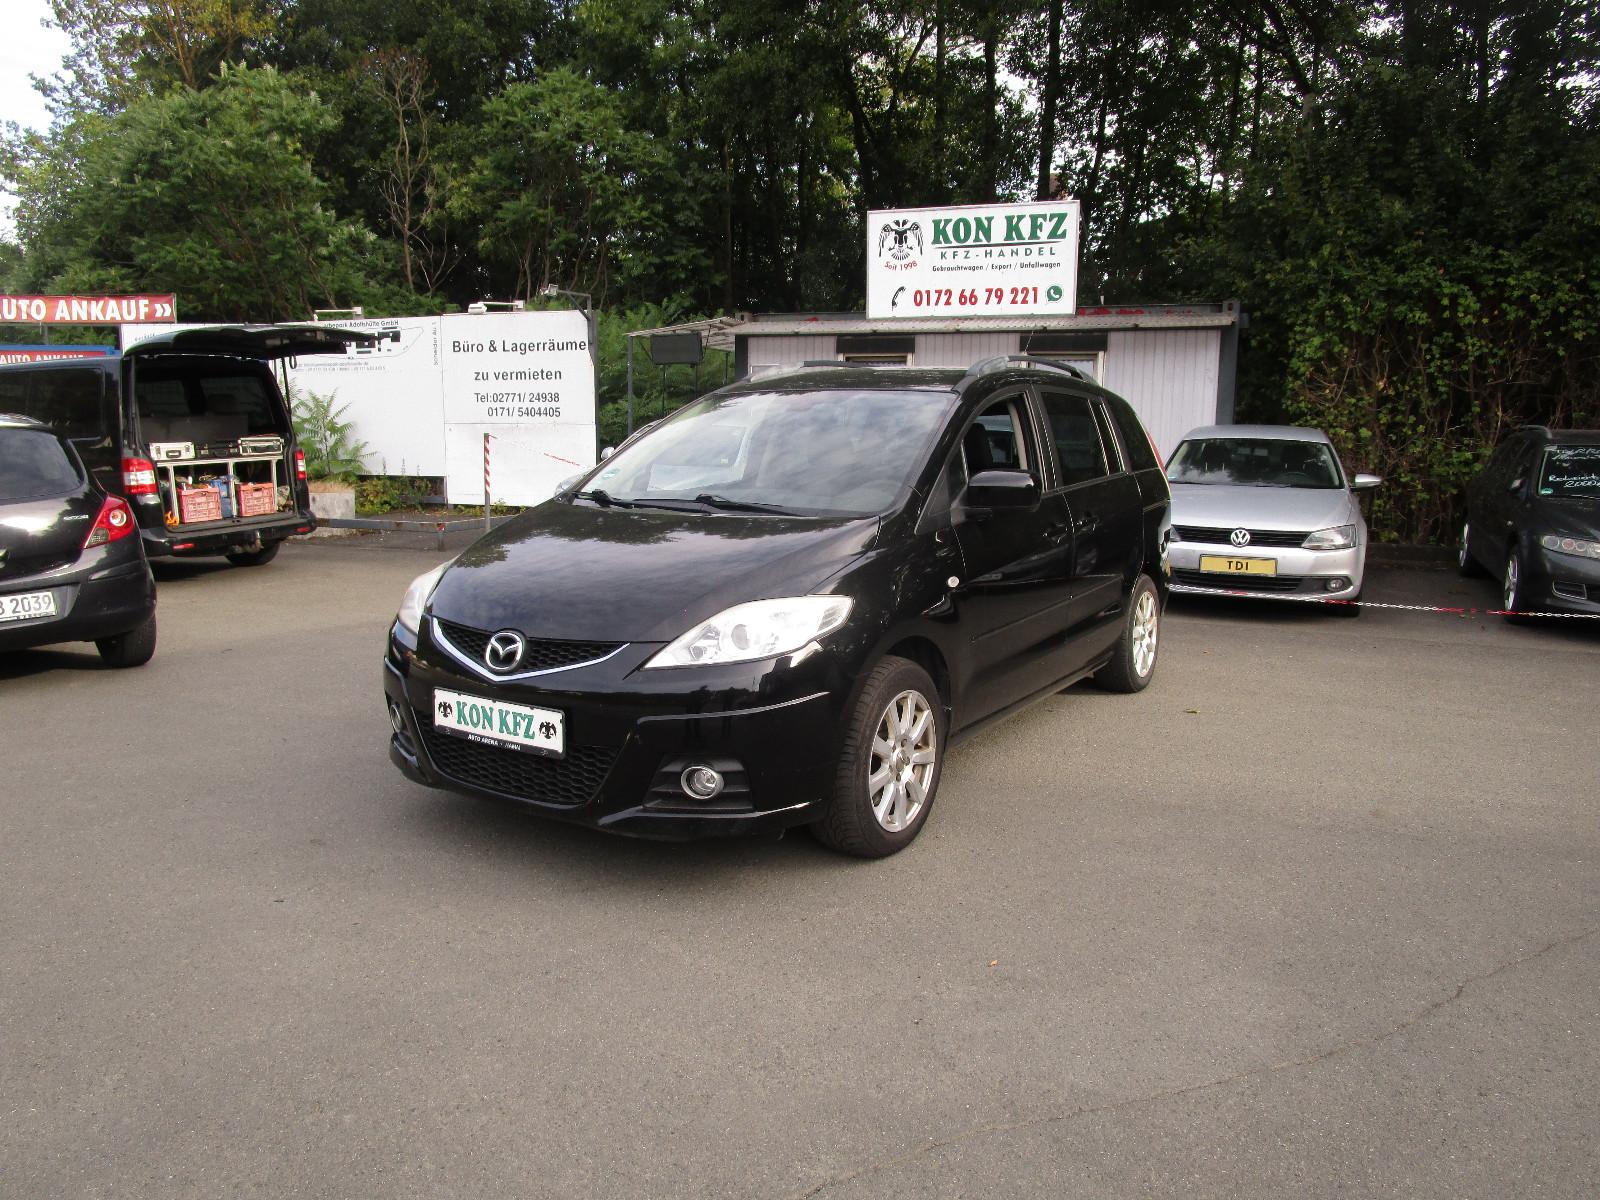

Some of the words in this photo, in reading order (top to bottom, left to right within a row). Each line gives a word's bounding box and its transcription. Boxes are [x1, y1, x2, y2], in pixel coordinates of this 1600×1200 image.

[931, 215, 994, 245] KON
[1004, 212, 1068, 241] KFZ
[940, 246, 1056, 260] KFZ-HANDEL
[932, 263, 984, 272] Gebrauchtwagen
[991, 263, 1012, 271] Export
[1020, 261, 1061, 270] Unfallwagen
[913, 289, 952, 307] 0172
[958, 288, 978, 306] 66
[985, 287, 1004, 305] 79
[1010, 286, 1038, 304] 221
[0, 298, 47, 321] UTO
[55, 299, 149, 321] ANKAUF
[452, 340, 484, 353] Büro
[488, 339, 497, 352] &
[502, 339, 587, 355] Lagerräume
[474, 371, 489, 381] zu
[493, 368, 562, 381] vermieten
[528, 392, 560, 403] 24938
[487, 407, 515, 418] 0171/
[517, 407, 561, 418] 5404405
[1227, 560, 1249, 571] TDI
[10, 594, 52, 614] 2039
[456, 700, 494, 731] KON
[497, 708, 536, 740] KFZ
